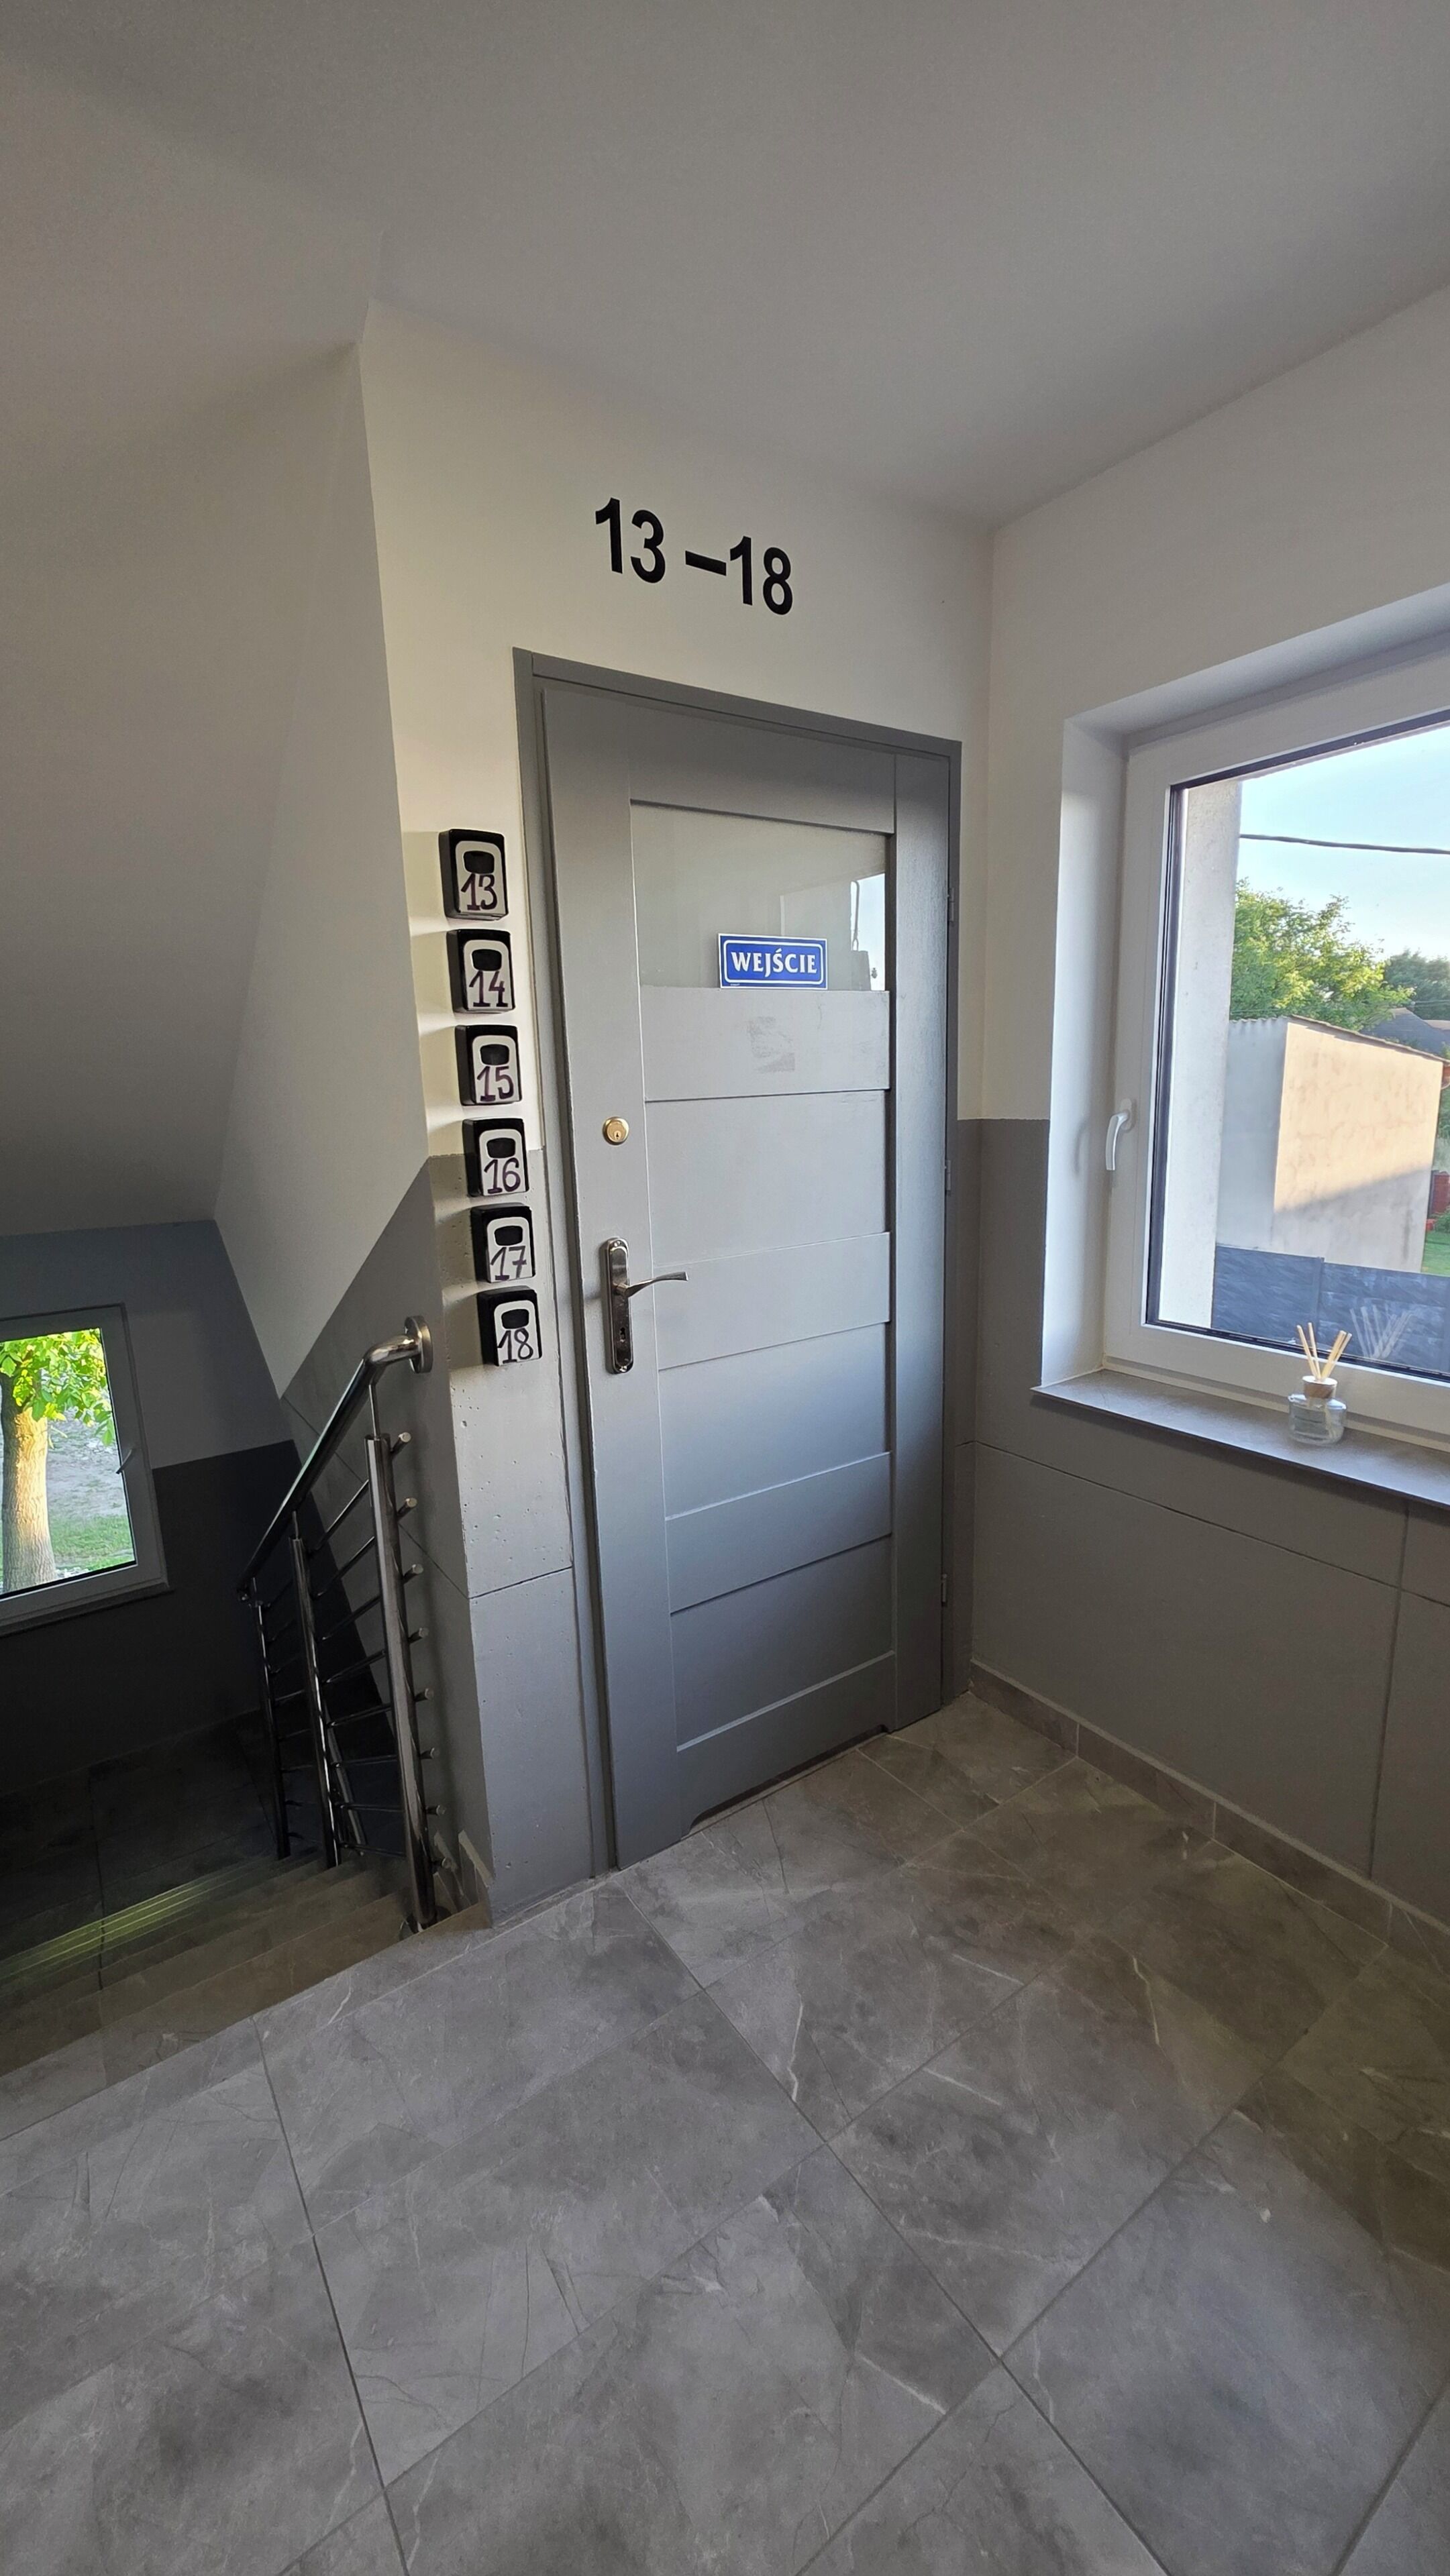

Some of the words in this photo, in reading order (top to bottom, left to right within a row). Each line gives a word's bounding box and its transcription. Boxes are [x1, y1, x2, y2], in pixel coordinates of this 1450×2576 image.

[460, 872, 498, 911] 13
[730, 948, 817, 977] WEJŚCIE
[468, 970, 509, 1008] 14
[476, 1066, 514, 1102] 15
[483, 1157, 521, 1194] 16
[490, 1246, 527, 1281] 17
[497, 1328, 534, 1364] 18
